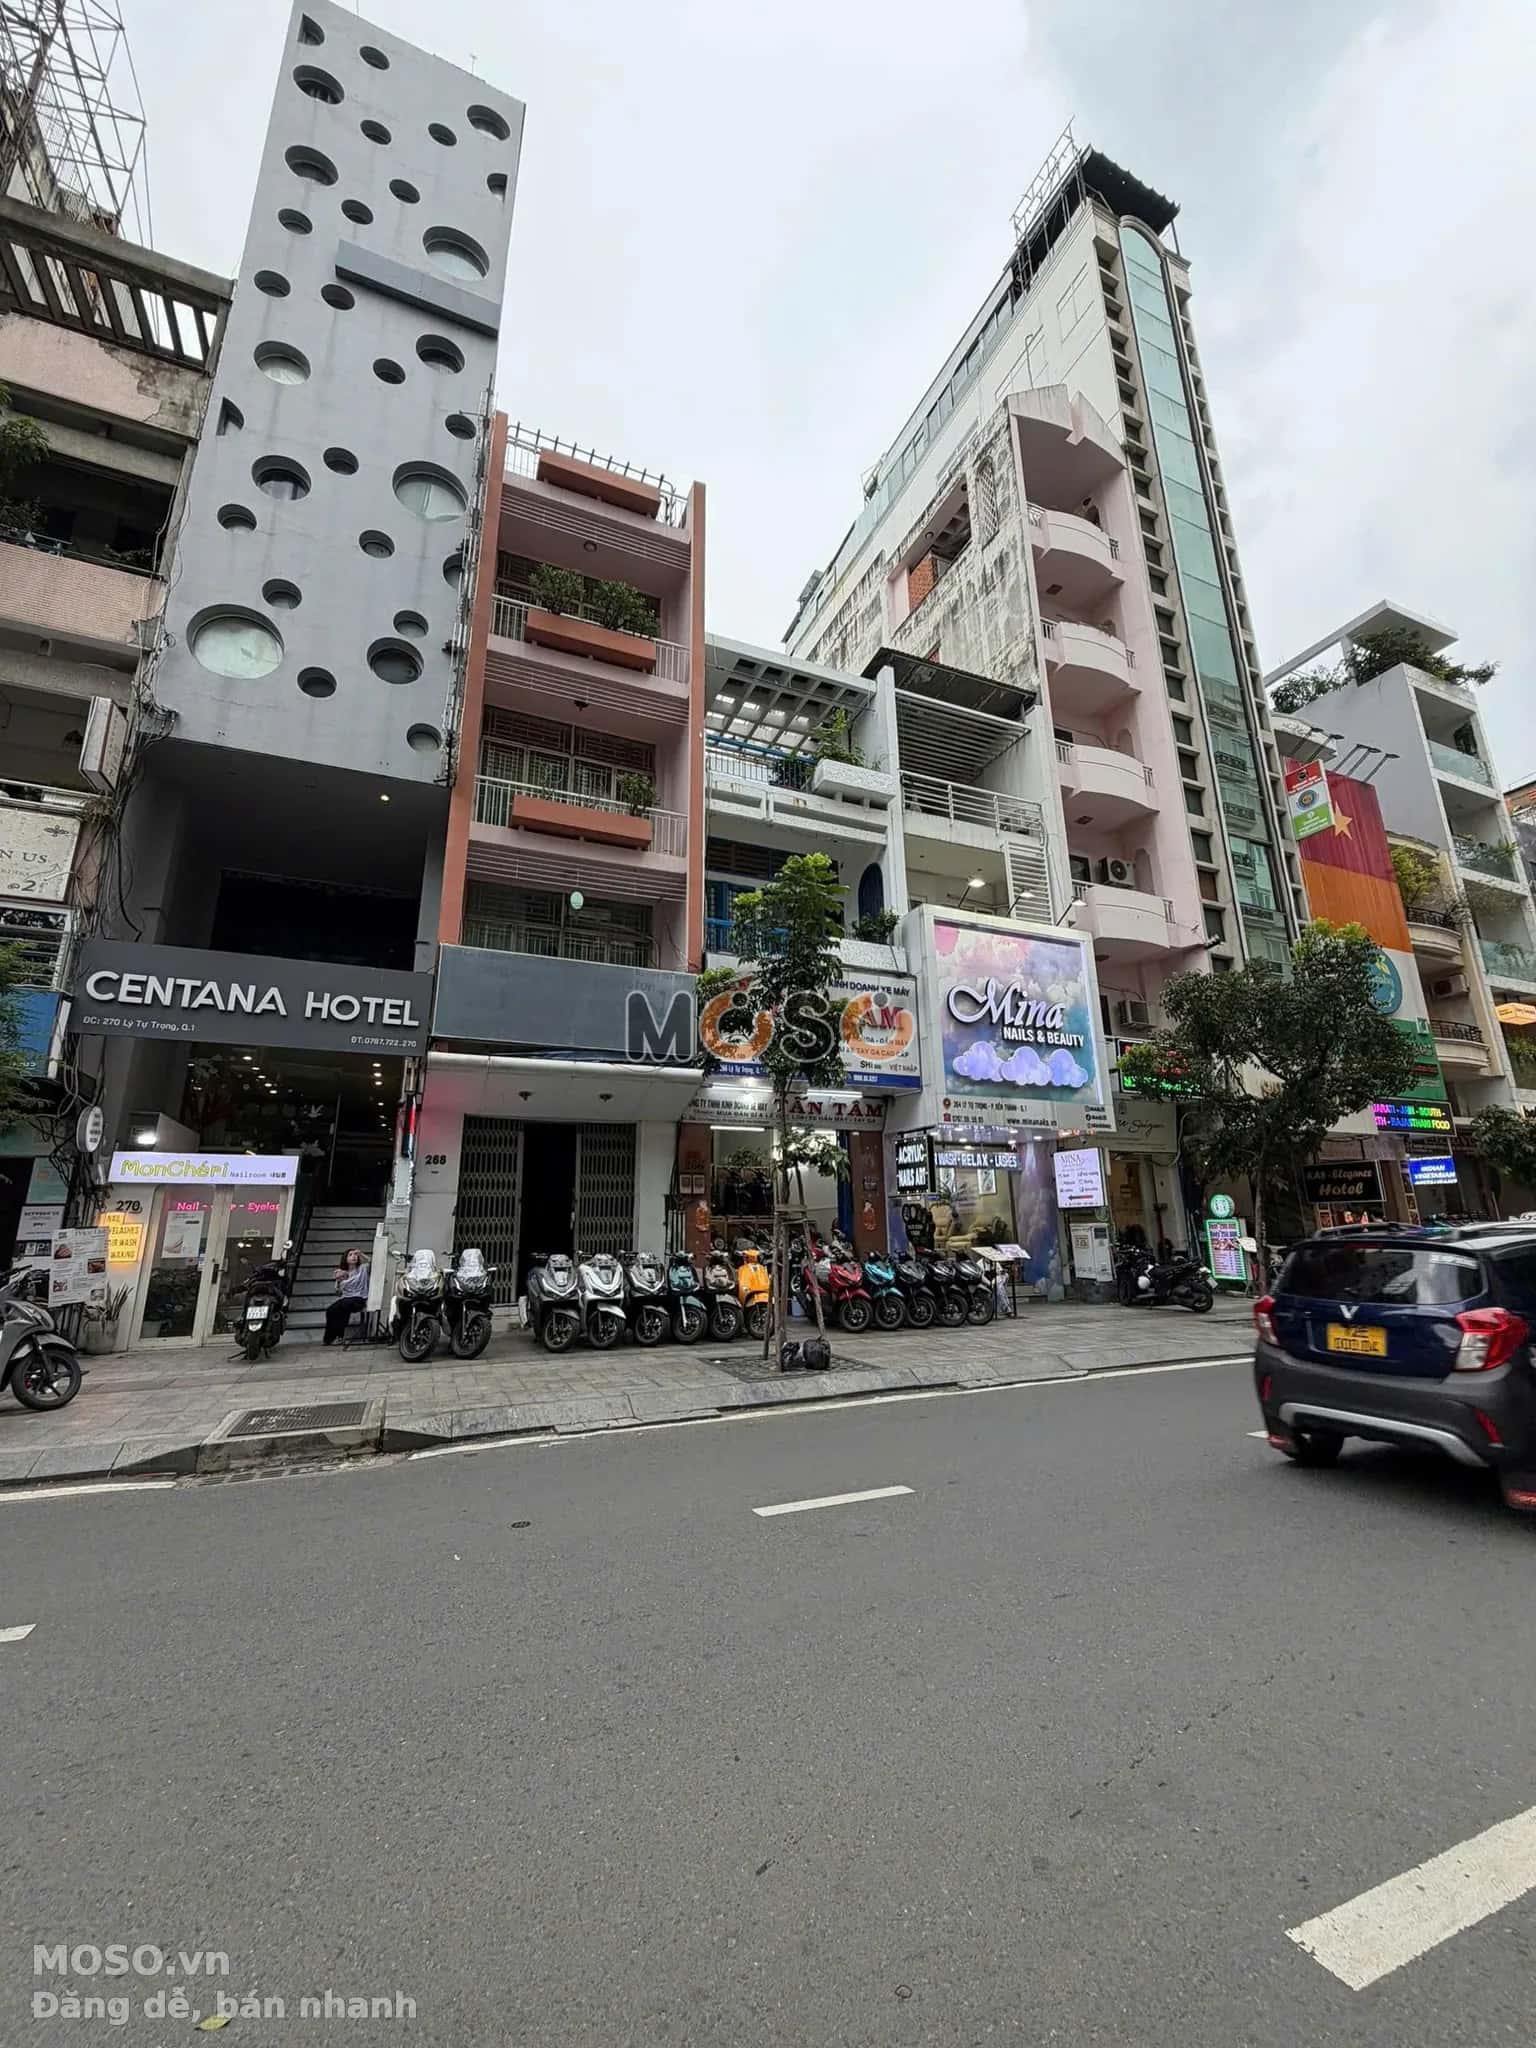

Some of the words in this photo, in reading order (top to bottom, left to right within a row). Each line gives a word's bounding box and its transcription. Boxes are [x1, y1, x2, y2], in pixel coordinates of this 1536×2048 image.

[849, 981, 879, 993] DOANH
[85, 970, 288, 1017] CENTANA
[303, 991, 420, 1027] HOTEL
[948, 977, 1067, 1029] Mina
[102, 1017, 121, 1026] 270
[1003, 1026, 1035, 1043] NAILS
[1036, 1031, 1046, 1044] &
[1047, 1031, 1085, 1048] BEAUTY
[1432, 1120, 1451, 1130] FOOD
[424, 1154, 447, 1165] 268
[961, 1153, 988, 1166] RELAX
[1319, 1181, 1364, 1196] Hotel
[116, 1200, 141, 1212] 270
[177, 1202, 200, 1211] Nail
